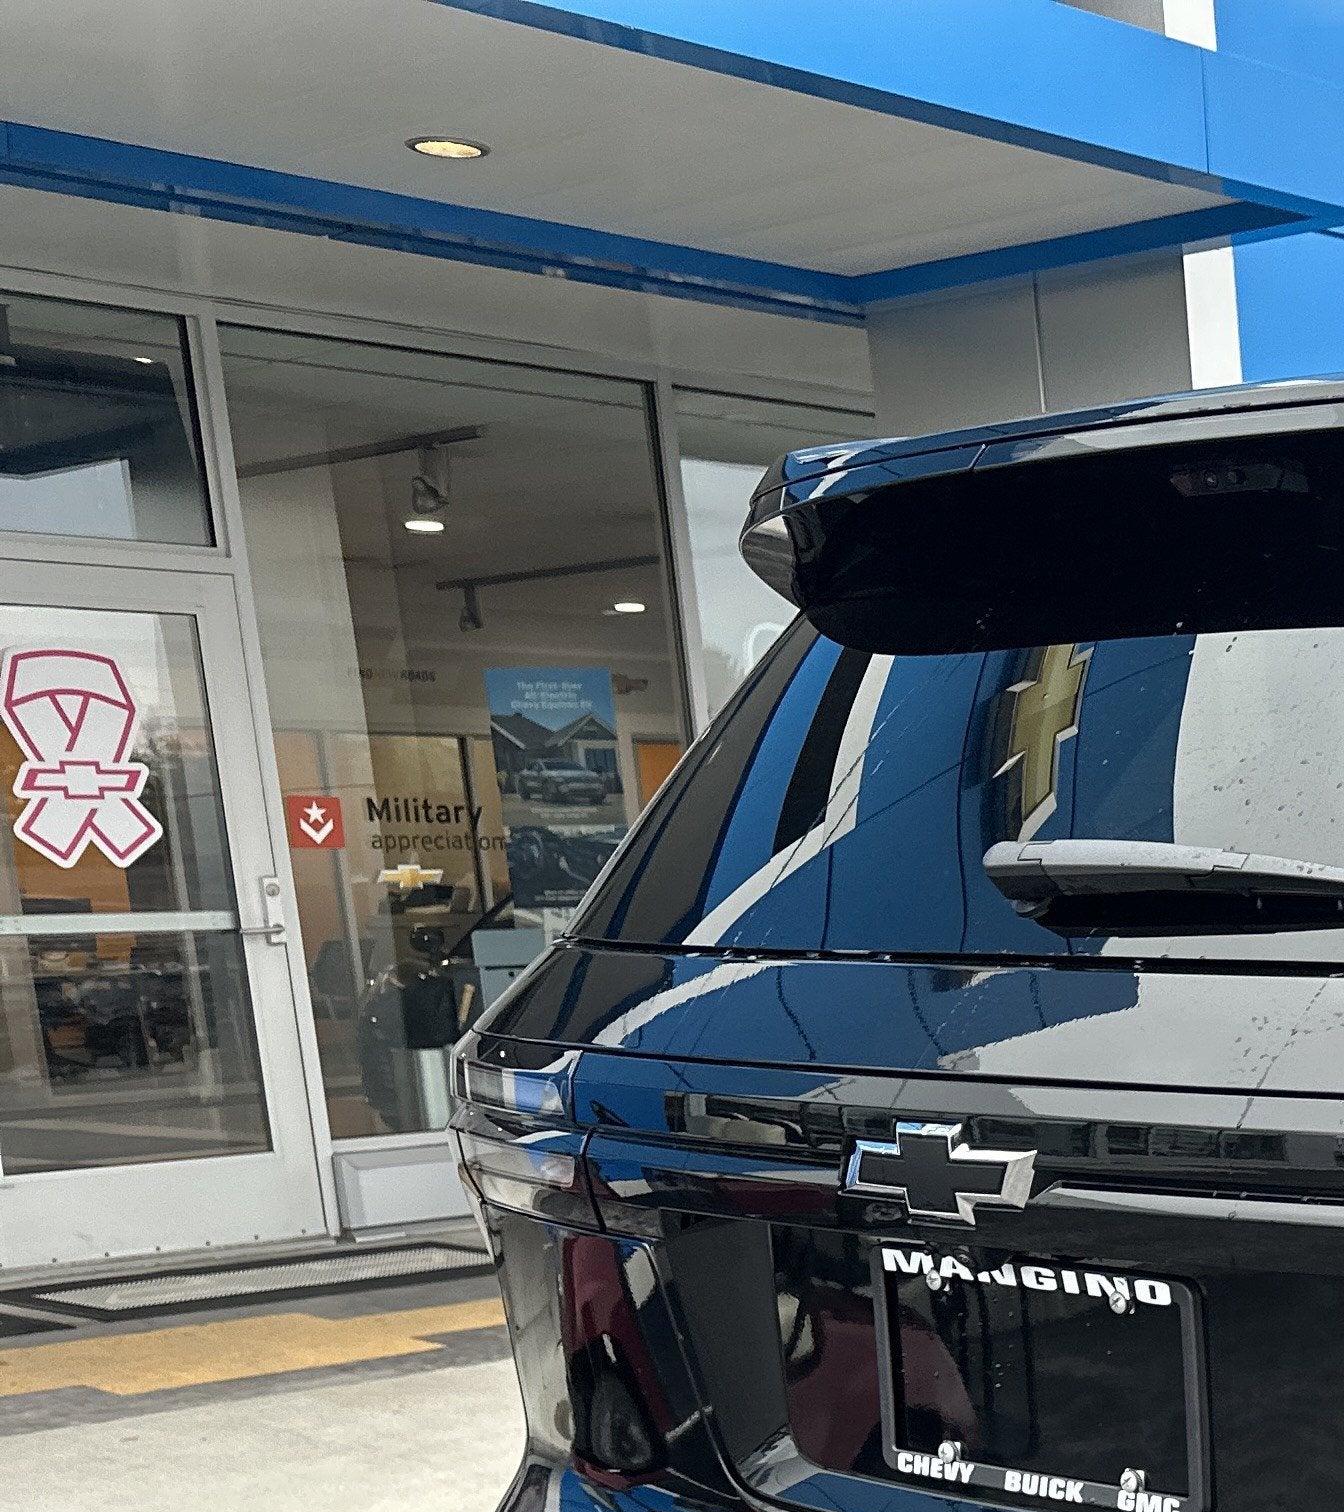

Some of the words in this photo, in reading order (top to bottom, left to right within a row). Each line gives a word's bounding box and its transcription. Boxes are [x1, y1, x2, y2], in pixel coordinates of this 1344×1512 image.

[366, 797, 482, 832] Military
[371, 828, 506, 854] appreciaton
[881, 1247, 1172, 1306] MANGINO
[897, 1452, 975, 1484] CHEVY
[1004, 1470, 1084, 1503] BUICK
